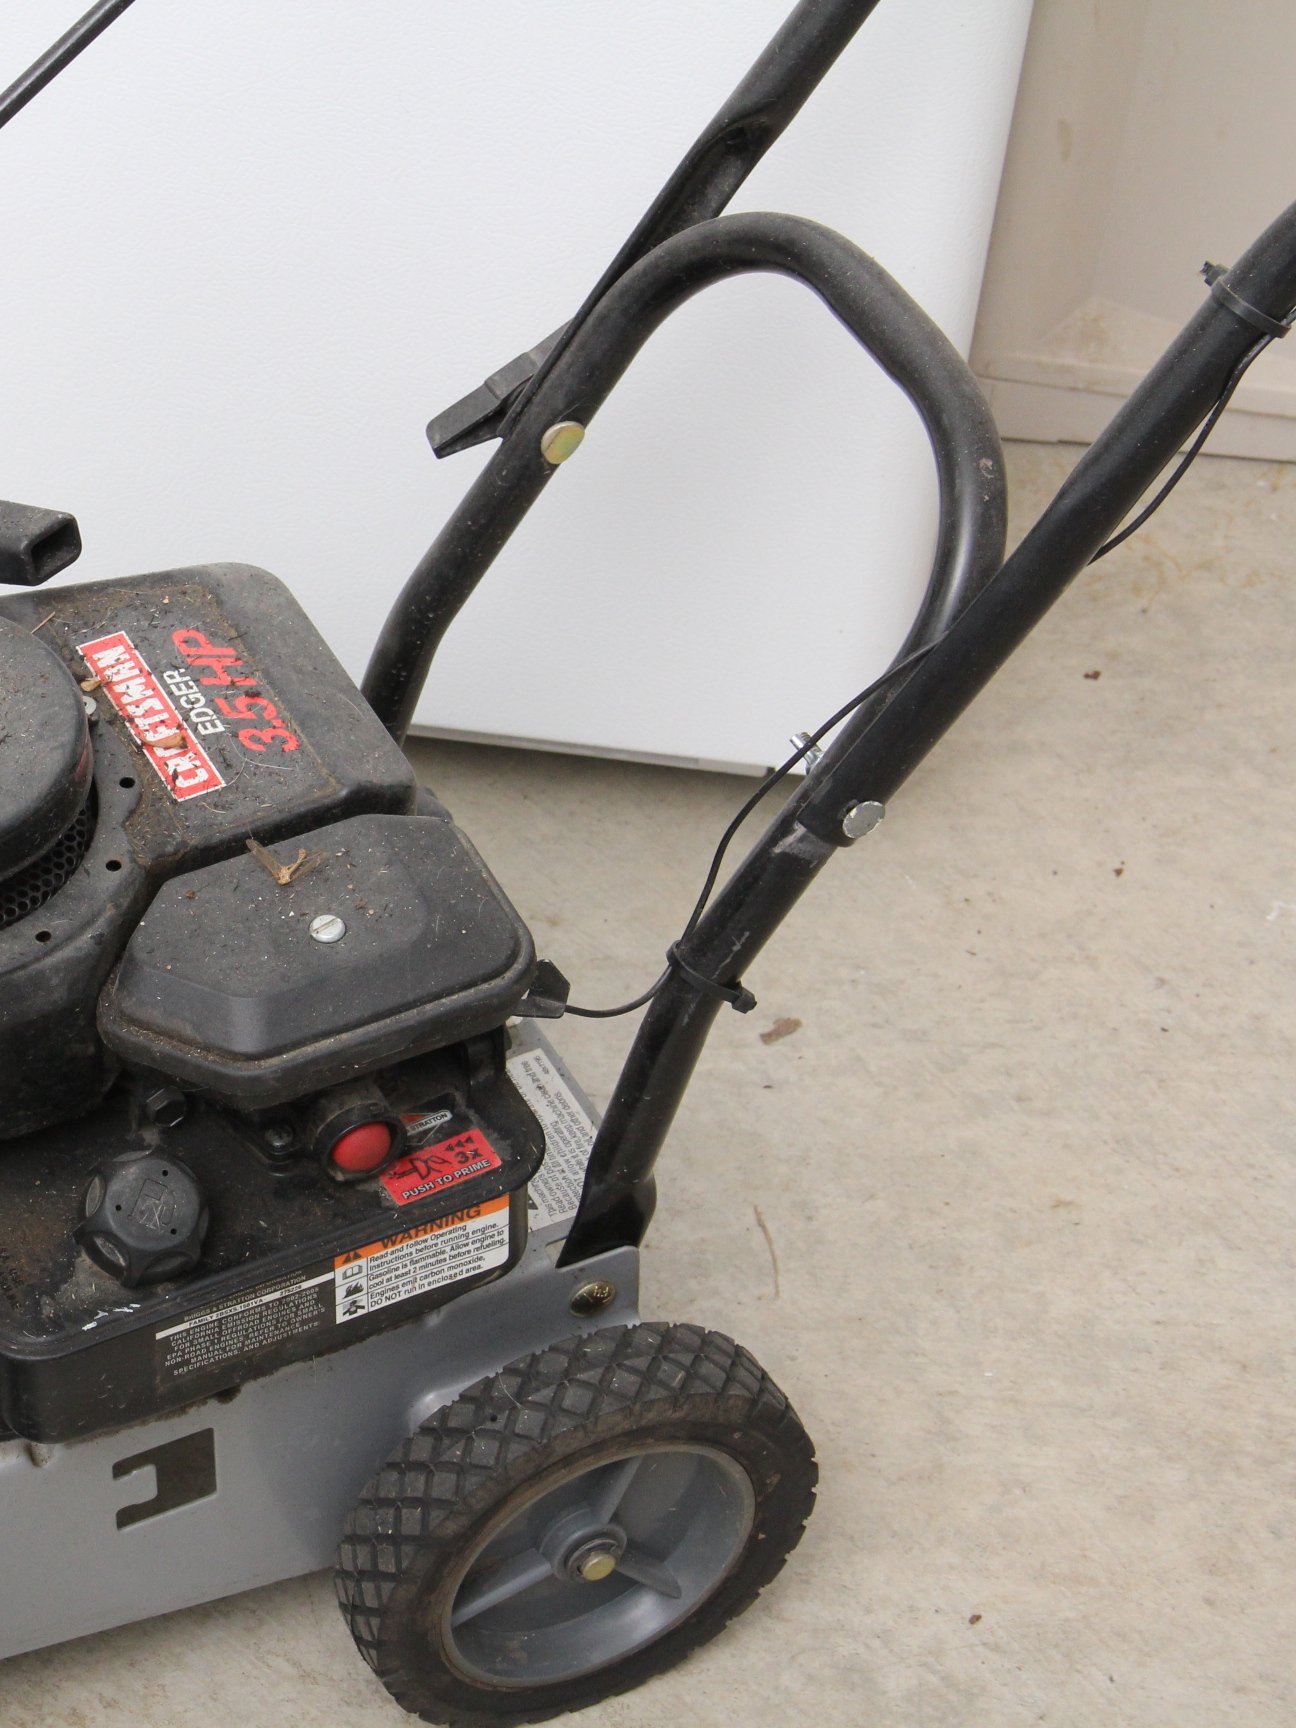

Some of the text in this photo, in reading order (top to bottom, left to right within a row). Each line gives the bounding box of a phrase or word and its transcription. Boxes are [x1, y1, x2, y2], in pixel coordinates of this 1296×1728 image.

[163, 668, 225, 735] EDGER
[172, 629, 300, 752] 3.5 HP
[409, 1113, 447, 1131] STRATTON
[402, 1159, 490, 1198] PUSH TO PRIME
[549, 1174, 559, 1182] of
[555, 1182, 577, 1210] Because
[574, 1178, 585, 1187] OT
[369, 1225, 466, 1263] Read and follow Operating
[369, 1223, 498, 1271] Instructions before running engine.
[381, 1205, 480, 1247] WARNING
[368, 1227, 504, 1281] Gasoline is flammable. Allow engine to
[368, 1278, 383, 1289] cool
[394, 1269, 410, 1279] least
[418, 1257, 446, 1270] minutes
[449, 1249, 471, 1260] before
[473, 1238, 505, 1252] refueling.
[184, 1309, 210, 1321] BRIGGS
[218, 1293, 254, 1309] STRATTON
[256, 1276, 305, 1296] CORPORATION
[370, 1285, 398, 1299] Engines
[419, 1268, 444, 1280] carbon
[447, 1256, 484, 1271] monoxide,
[370, 1298, 382, 1306] DO
[384, 1290, 401, 1301] NOT
[404, 1286, 416, 1294] run
[427, 1269, 463, 1286] enclosed
[464, 1264, 482, 1273] area.
[164, 1349, 206, 1366] NON-ROAD
[248, 1326, 273, 1338] REFER
[290, 1307, 324, 1323] OWNER'S
[166, 1351, 182, 1360] EPA
[185, 1341, 210, 1353] PHASE
[220, 1320, 276, 1341] REGULATIONS
[279, 1312, 293, 1321] FOR
[297, 1303, 322, 1315] SMALL
[170, 1332, 186, 1341] THIS
[189, 1321, 218, 1334] ENGINE
[222, 1306, 264, 1323] CONFORMS
[171, 1328, 218, 1346] CALIFORNIA
[222, 1311, 258, 1329] EMISSION
[262, 1293, 317, 1315] REGULATIONS
[174, 1300, 314, 1351] FOR SMALL OFFROAD ENGINES AND
[188, 1315, 212, 1326] FAMILY
[190, 1349, 222, 1363] MANUAL
[226, 1343, 241, 1351] FOR
[243, 1343, 258, 1351] AND
